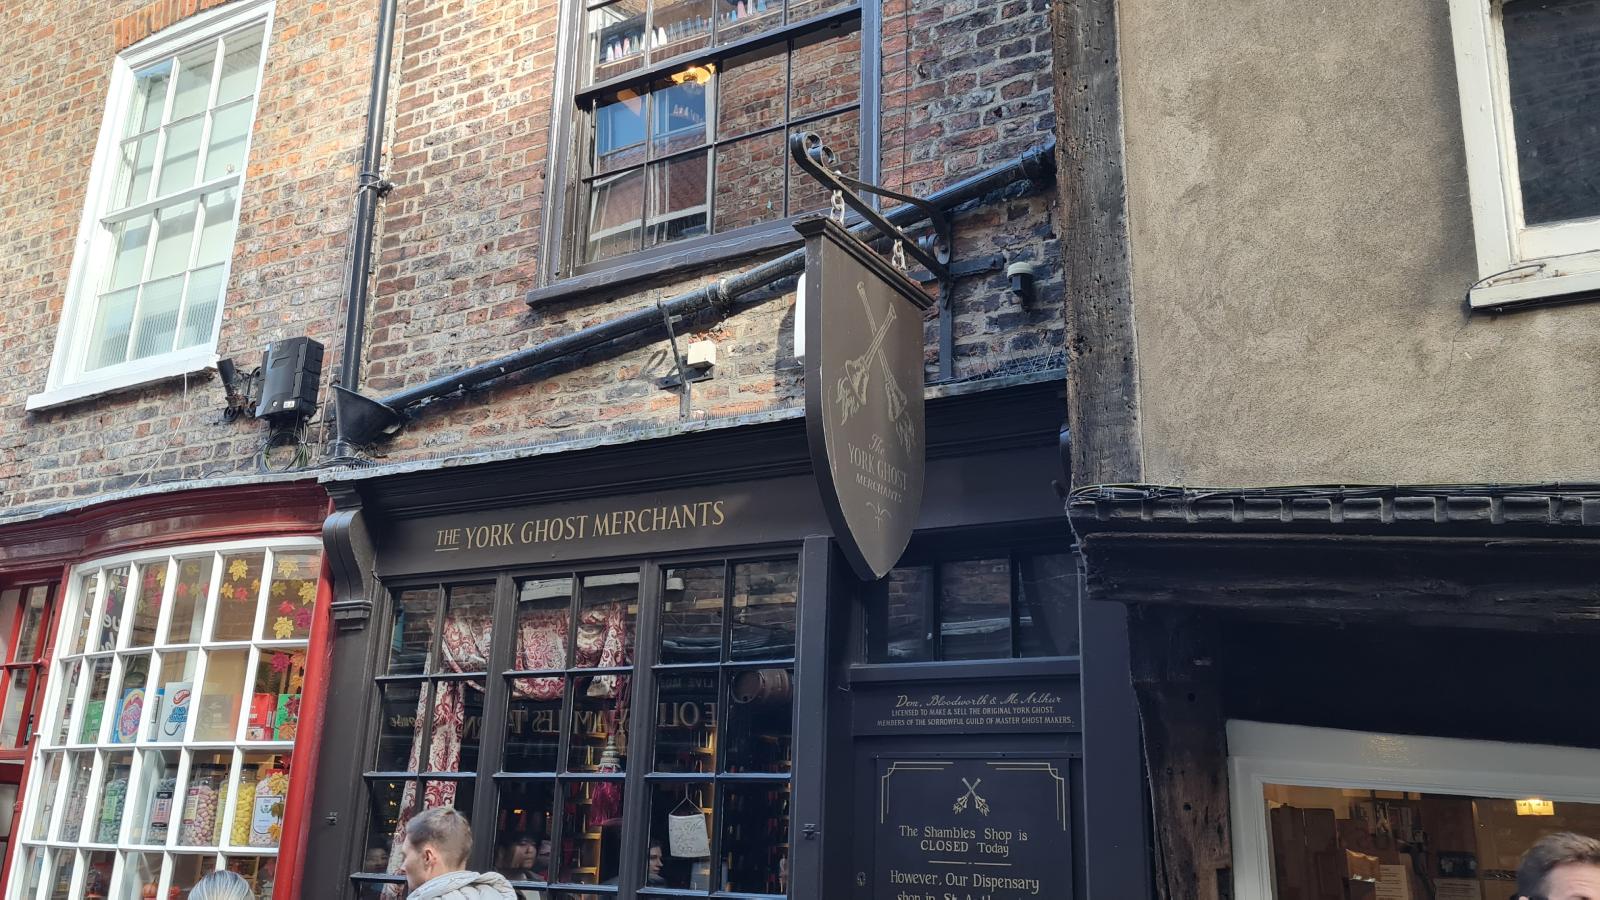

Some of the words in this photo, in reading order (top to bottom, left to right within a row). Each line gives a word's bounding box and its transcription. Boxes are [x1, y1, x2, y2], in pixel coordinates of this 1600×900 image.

[869, 433, 885, 455] The
[848, 442, 874, 475] YORK
[878, 459, 908, 491] GHOST
[856, 472, 902, 503] MERCHANTS
[436, 528, 461, 547] THE
[465, 522, 516, 549] YORK
[520, 515, 588, 544] GHOST
[592, 500, 725, 537] MERCHANTS
[926, 694, 990, 707] Bloodworth
[990, 696, 997, 705] &
[877, 719, 905, 727] MEMBERS
[915, 718, 926, 726] THE
[928, 718, 964, 726] SORROWFUL
[966, 717, 984, 725] GUILD
[986, 717, 994, 725] OF
[995, 717, 1020, 725] MASTER
[1021, 716, 1043, 724] GHOST
[891, 709, 918, 717] LICENSED
[920, 709, 928, 717] TO
[929, 708, 946, 716] MAKE
[969, 707, 981, 715] THE
[982, 707, 1012, 715] ORIGINAL
[1013, 706, 1030, 714] YORK
[898, 825, 918, 837] The
[924, 826, 976, 840] Shambles
[984, 827, 1012, 843] Shop
[1018, 829, 1028, 841] is
[920, 840, 969, 852] CLOSED
[976, 842, 1009, 857] Today
[890, 870, 942, 886] However,
[945, 872, 968, 887] Our
[973, 874, 1040, 894] Dispensary
